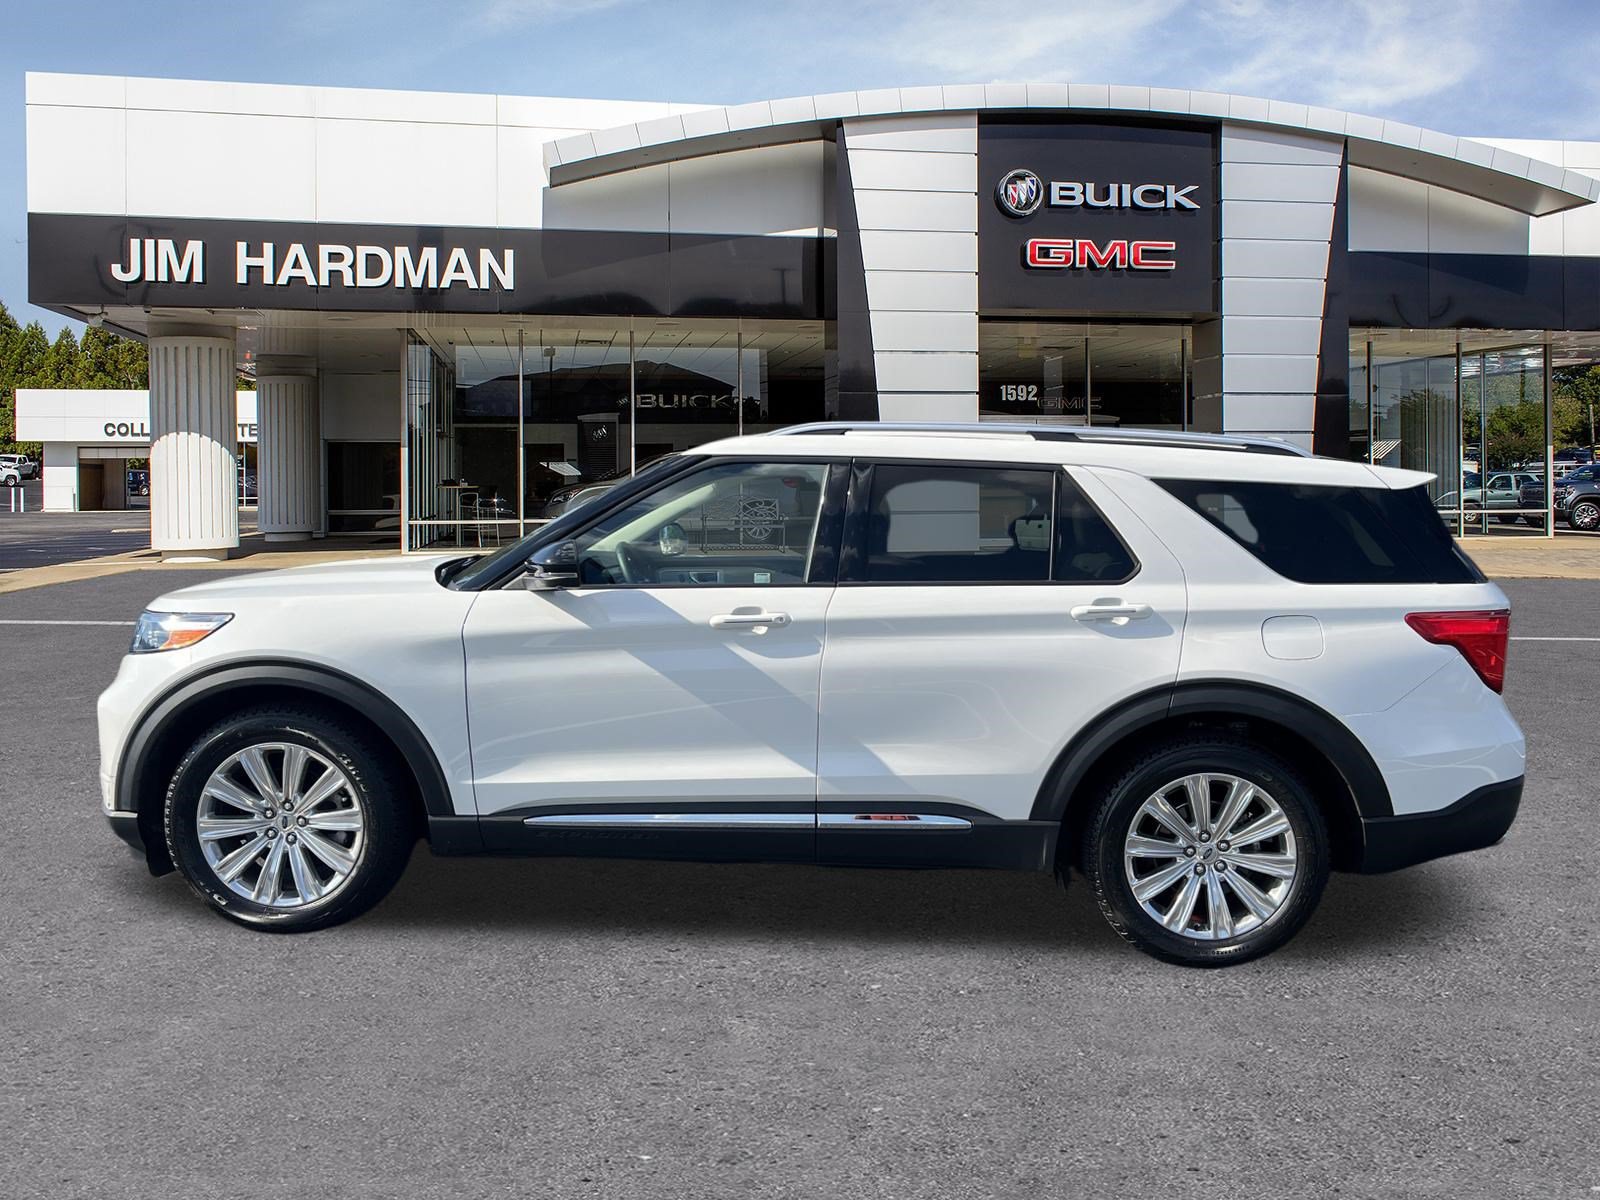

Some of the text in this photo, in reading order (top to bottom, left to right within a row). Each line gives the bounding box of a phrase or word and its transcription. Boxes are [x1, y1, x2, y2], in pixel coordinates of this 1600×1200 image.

[1050, 181, 1200, 209] BUICK
[111, 238, 515, 290] JIM HARDMAN
[1026, 238, 1176, 270] GMC
[636, 394, 732, 408] BUICK
[1000, 384, 1038, 401] 1592
[1037, 397, 1102, 409] GMC
